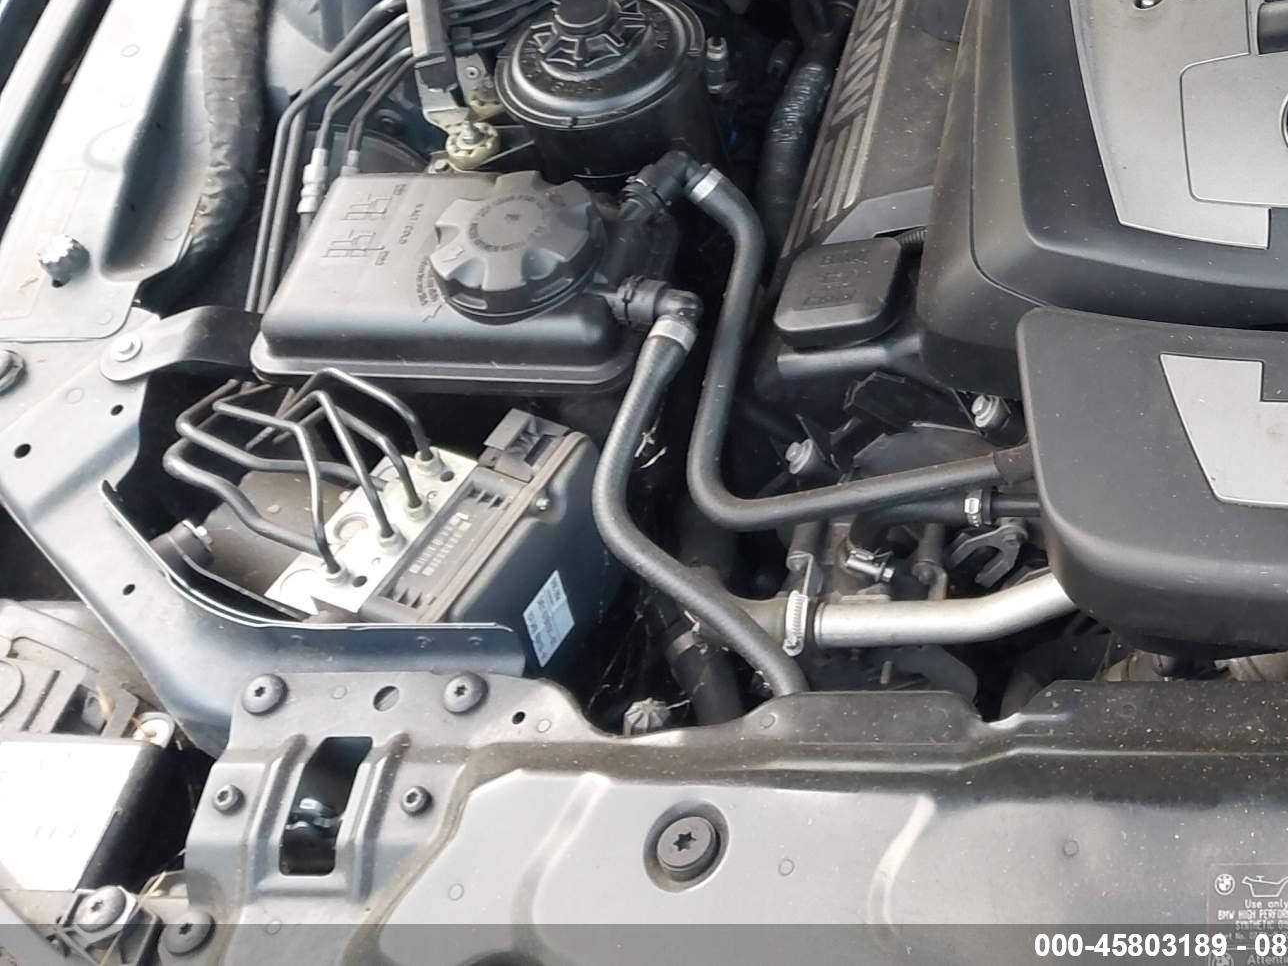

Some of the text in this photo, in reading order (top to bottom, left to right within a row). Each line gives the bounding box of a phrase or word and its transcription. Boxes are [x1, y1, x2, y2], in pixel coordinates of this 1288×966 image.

[1244, 898, 1263, 909] Use
[1217, 909, 1235, 921] BMW
[1238, 909, 1257, 920] HIGH
